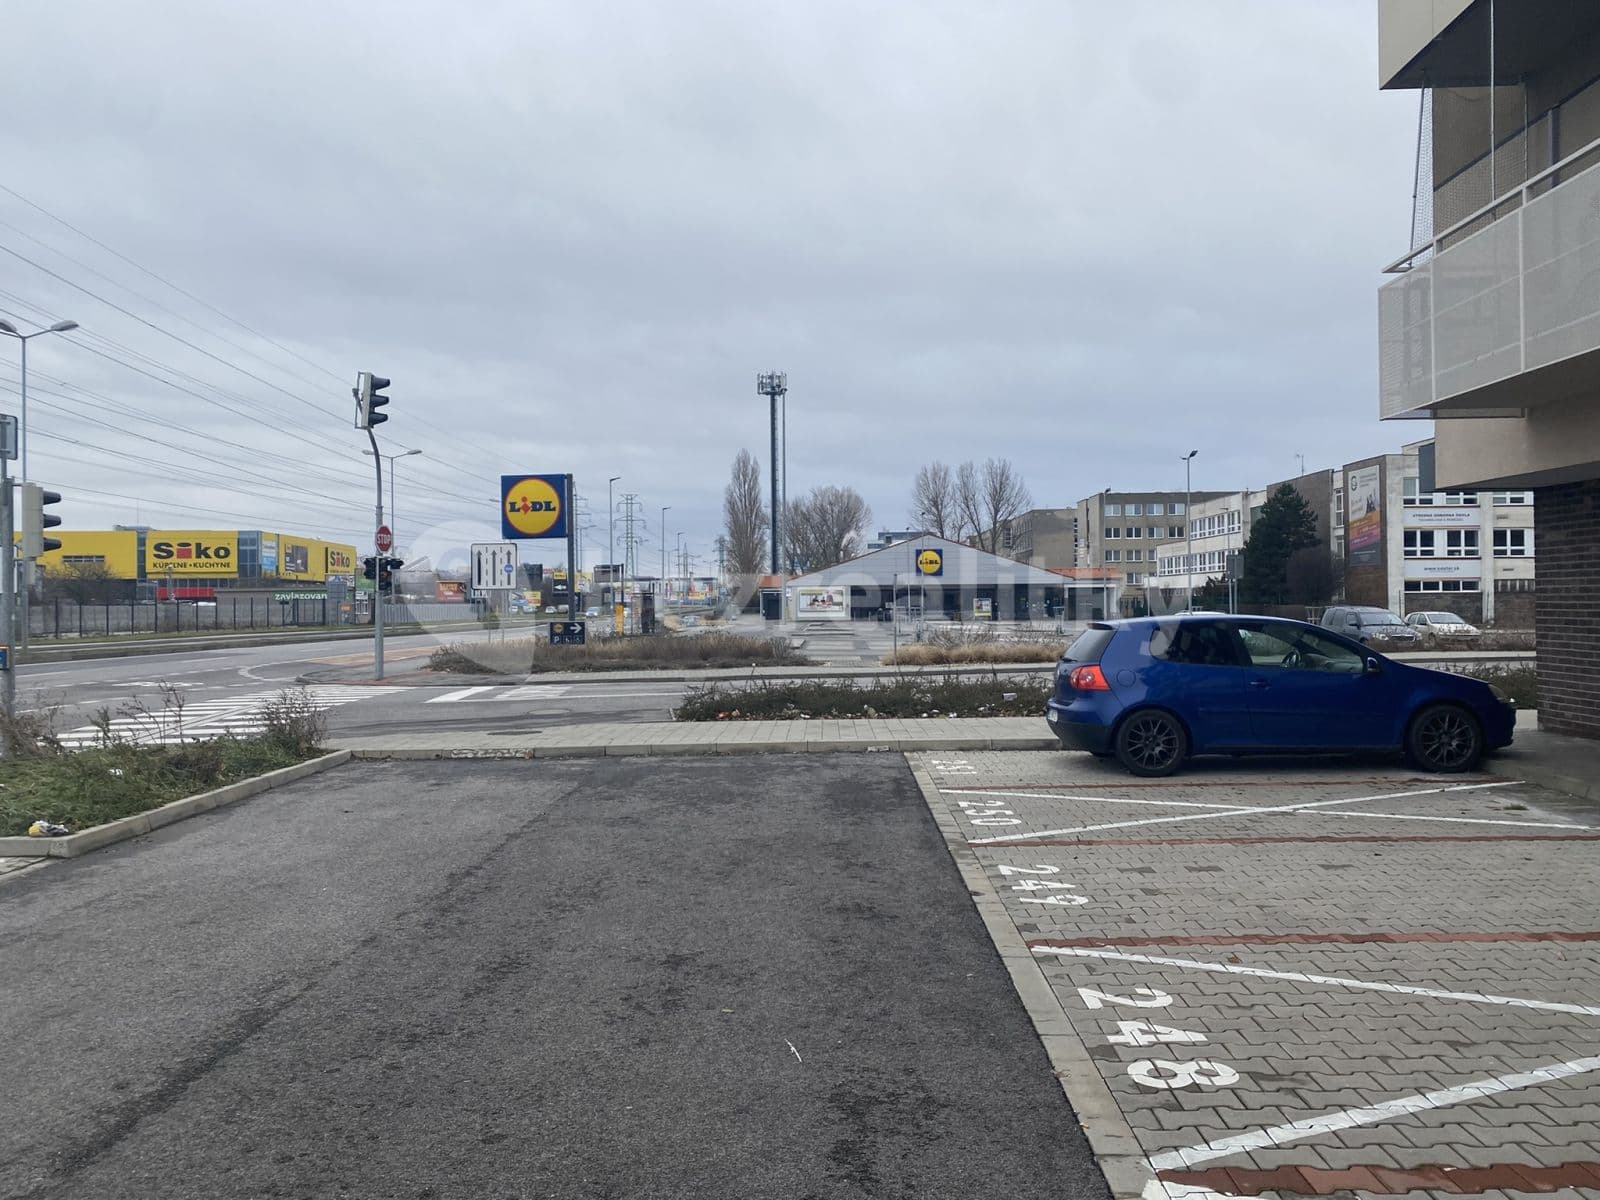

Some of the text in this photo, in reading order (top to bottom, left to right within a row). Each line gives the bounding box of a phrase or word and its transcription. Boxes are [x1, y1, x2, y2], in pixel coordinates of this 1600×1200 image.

[377, 533, 391, 545] STOP
[153, 542, 231, 559] Siko
[330, 550, 350, 568] Siko
[957, 800, 1023, 827] 250
[997, 863, 1090, 907] 249
[1076, 986, 1241, 1091] 248
